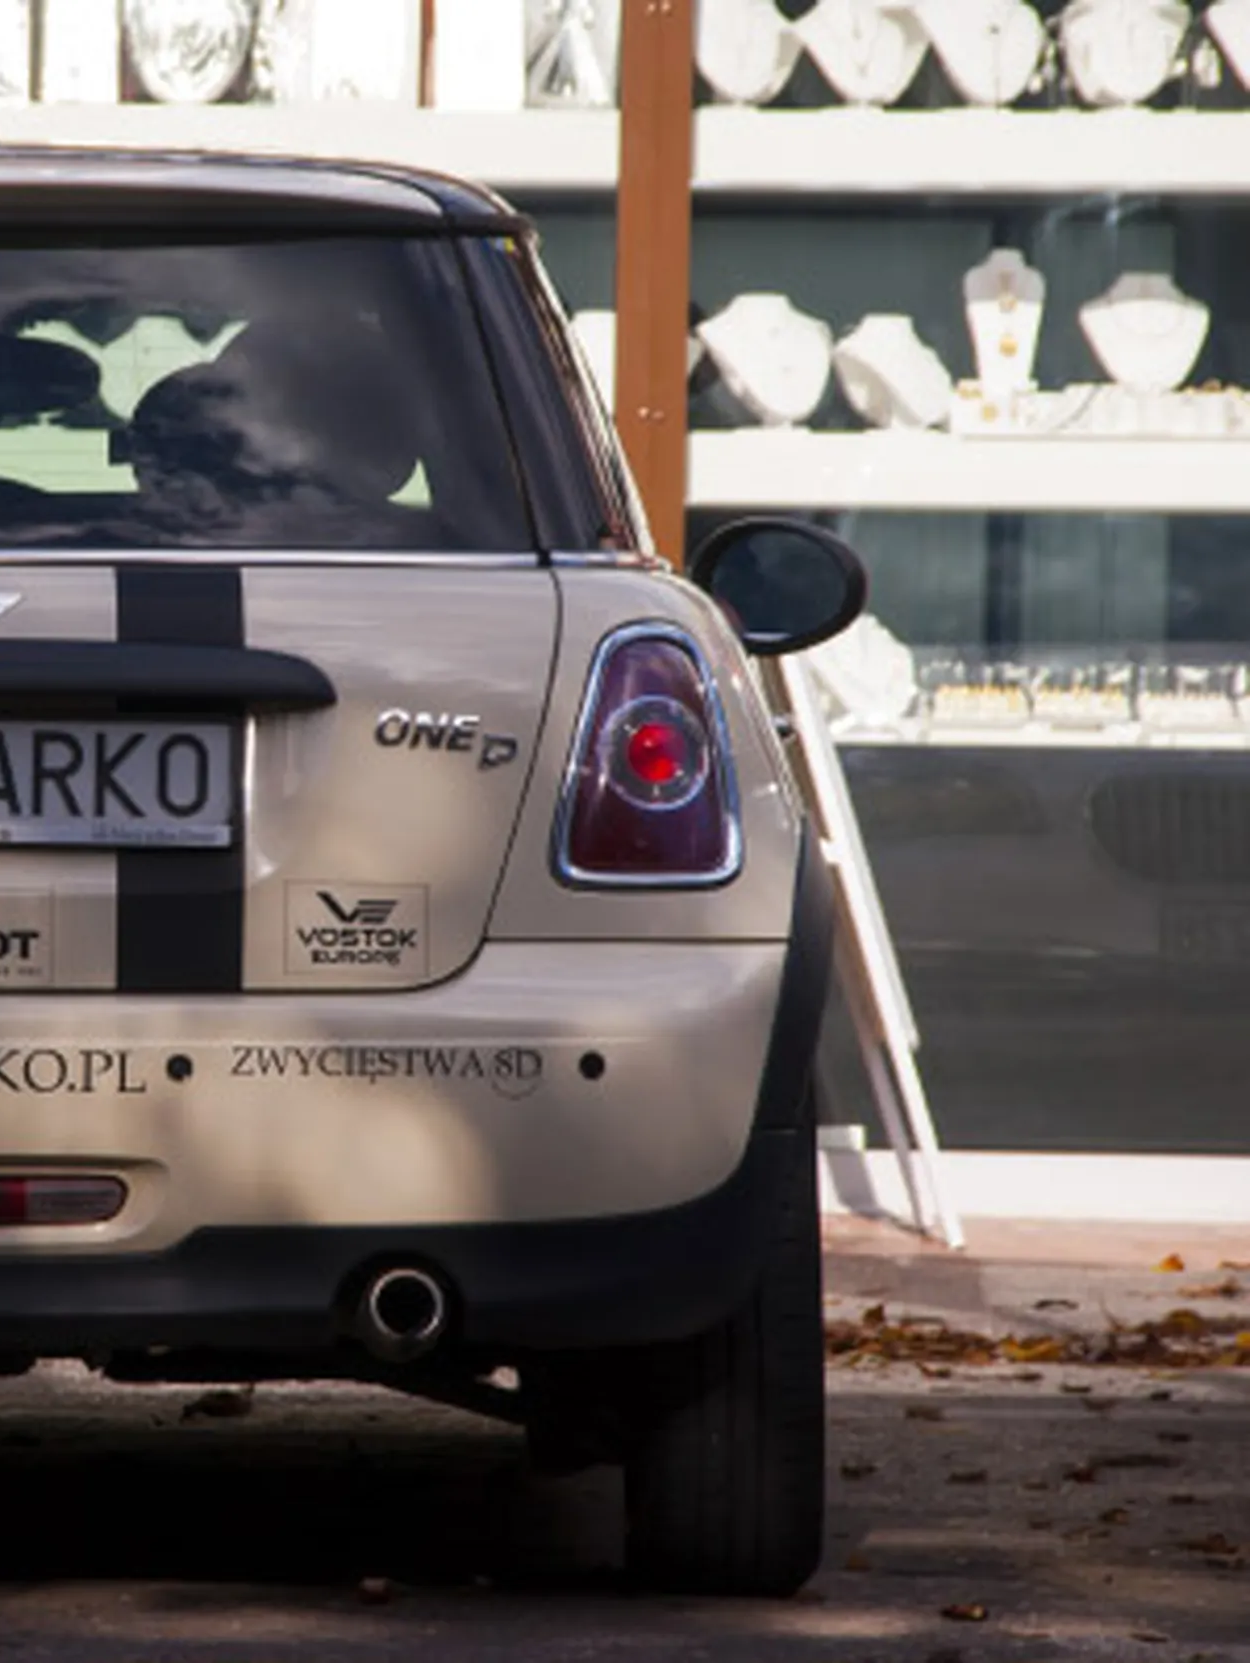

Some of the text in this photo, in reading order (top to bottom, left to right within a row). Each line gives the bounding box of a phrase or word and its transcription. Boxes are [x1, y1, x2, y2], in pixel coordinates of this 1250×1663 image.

[374, 707, 480, 750] ONE
[297, 929, 417, 948] VOSTOK
[231, 1045, 485, 1084] ZWYCIĘSTWA
